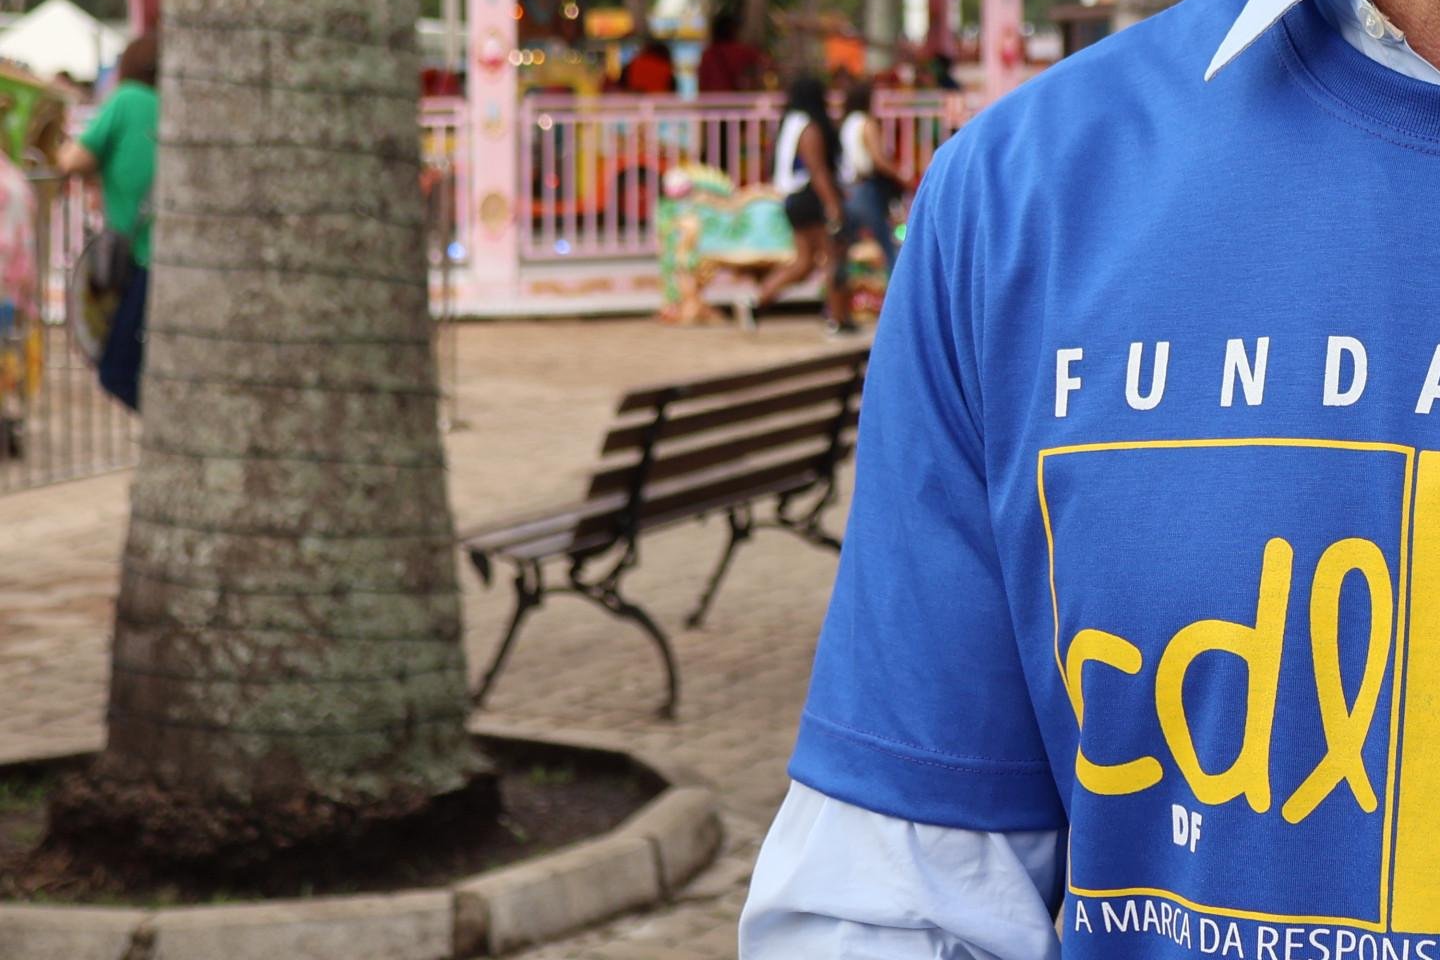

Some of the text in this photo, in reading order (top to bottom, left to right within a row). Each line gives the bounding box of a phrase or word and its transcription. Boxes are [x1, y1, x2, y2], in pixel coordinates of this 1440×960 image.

[1171, 803, 1203, 854] DF
[1074, 899, 1093, 934] A
[1101, 899, 1192, 950] MARCA
[1199, 917, 1245, 959] DA
